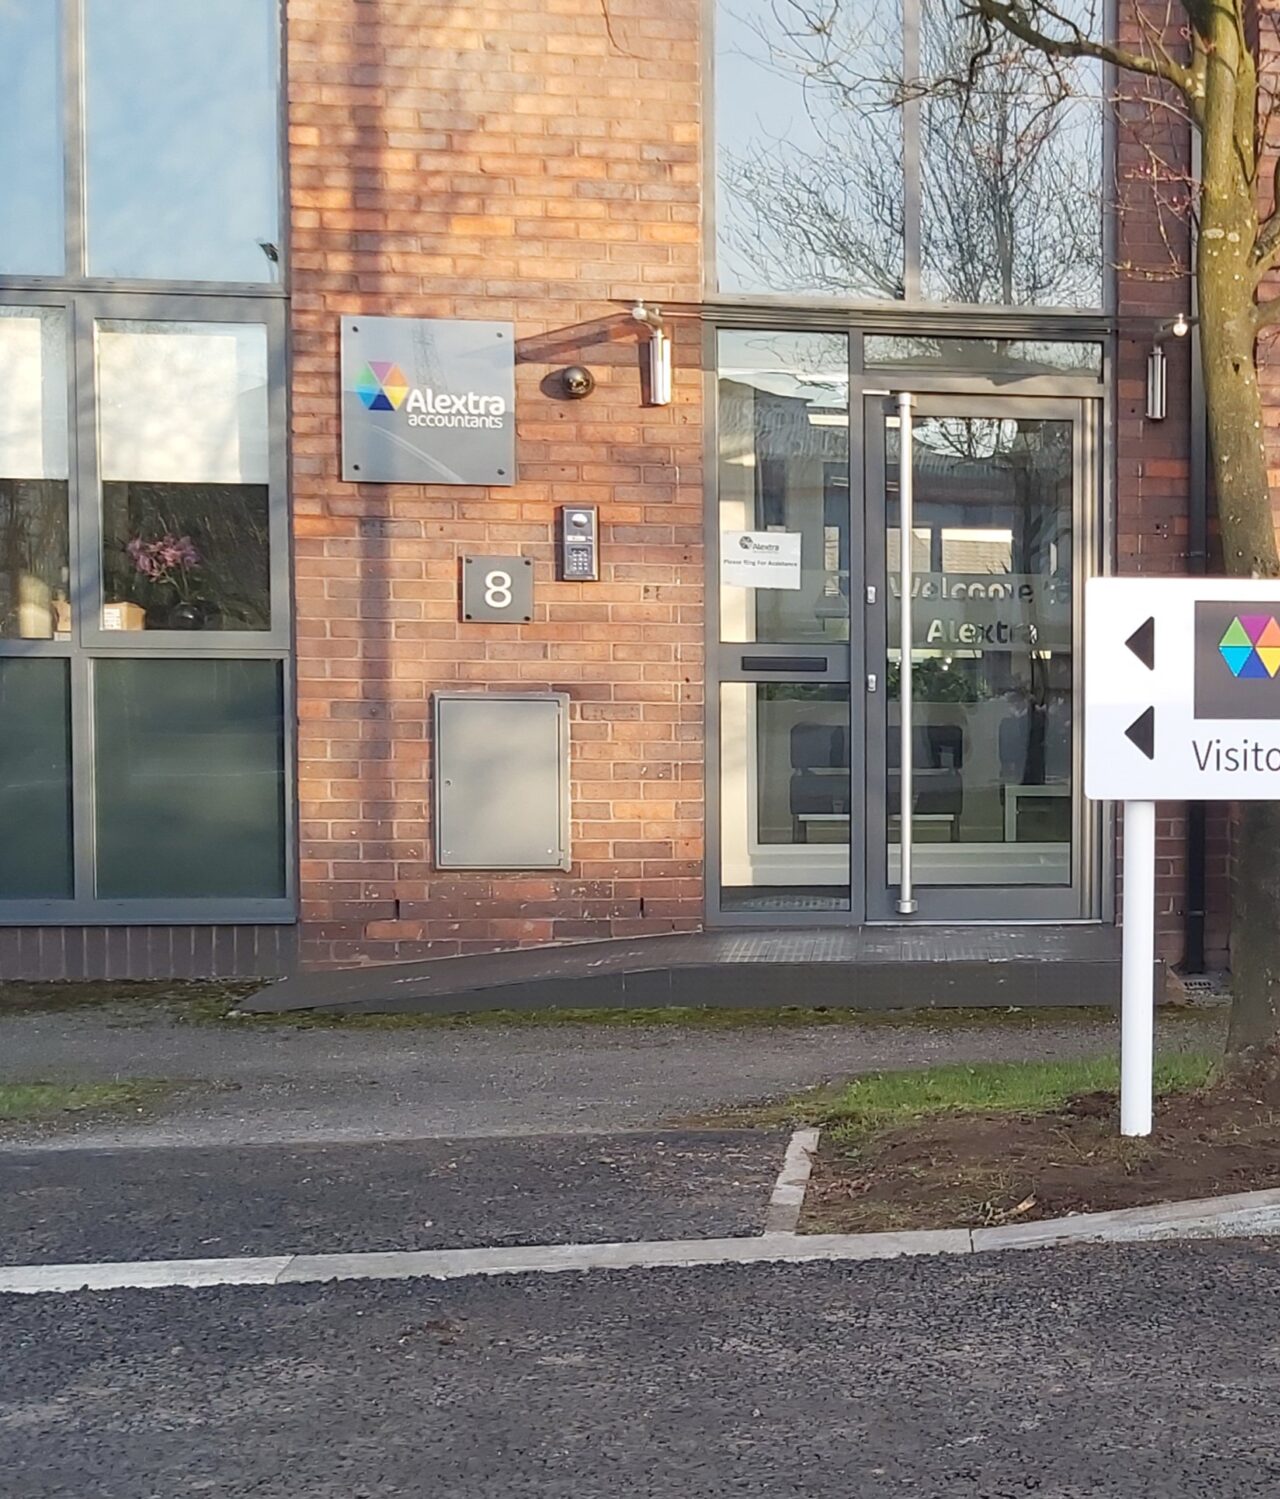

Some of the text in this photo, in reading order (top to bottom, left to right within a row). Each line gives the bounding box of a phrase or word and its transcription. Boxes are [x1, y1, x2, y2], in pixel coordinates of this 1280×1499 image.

[406, 388, 506, 415] Alextra
[408, 413, 503, 429] accountants
[484, 571, 512, 608] 8
[889, 577, 1034, 603] Welcome
